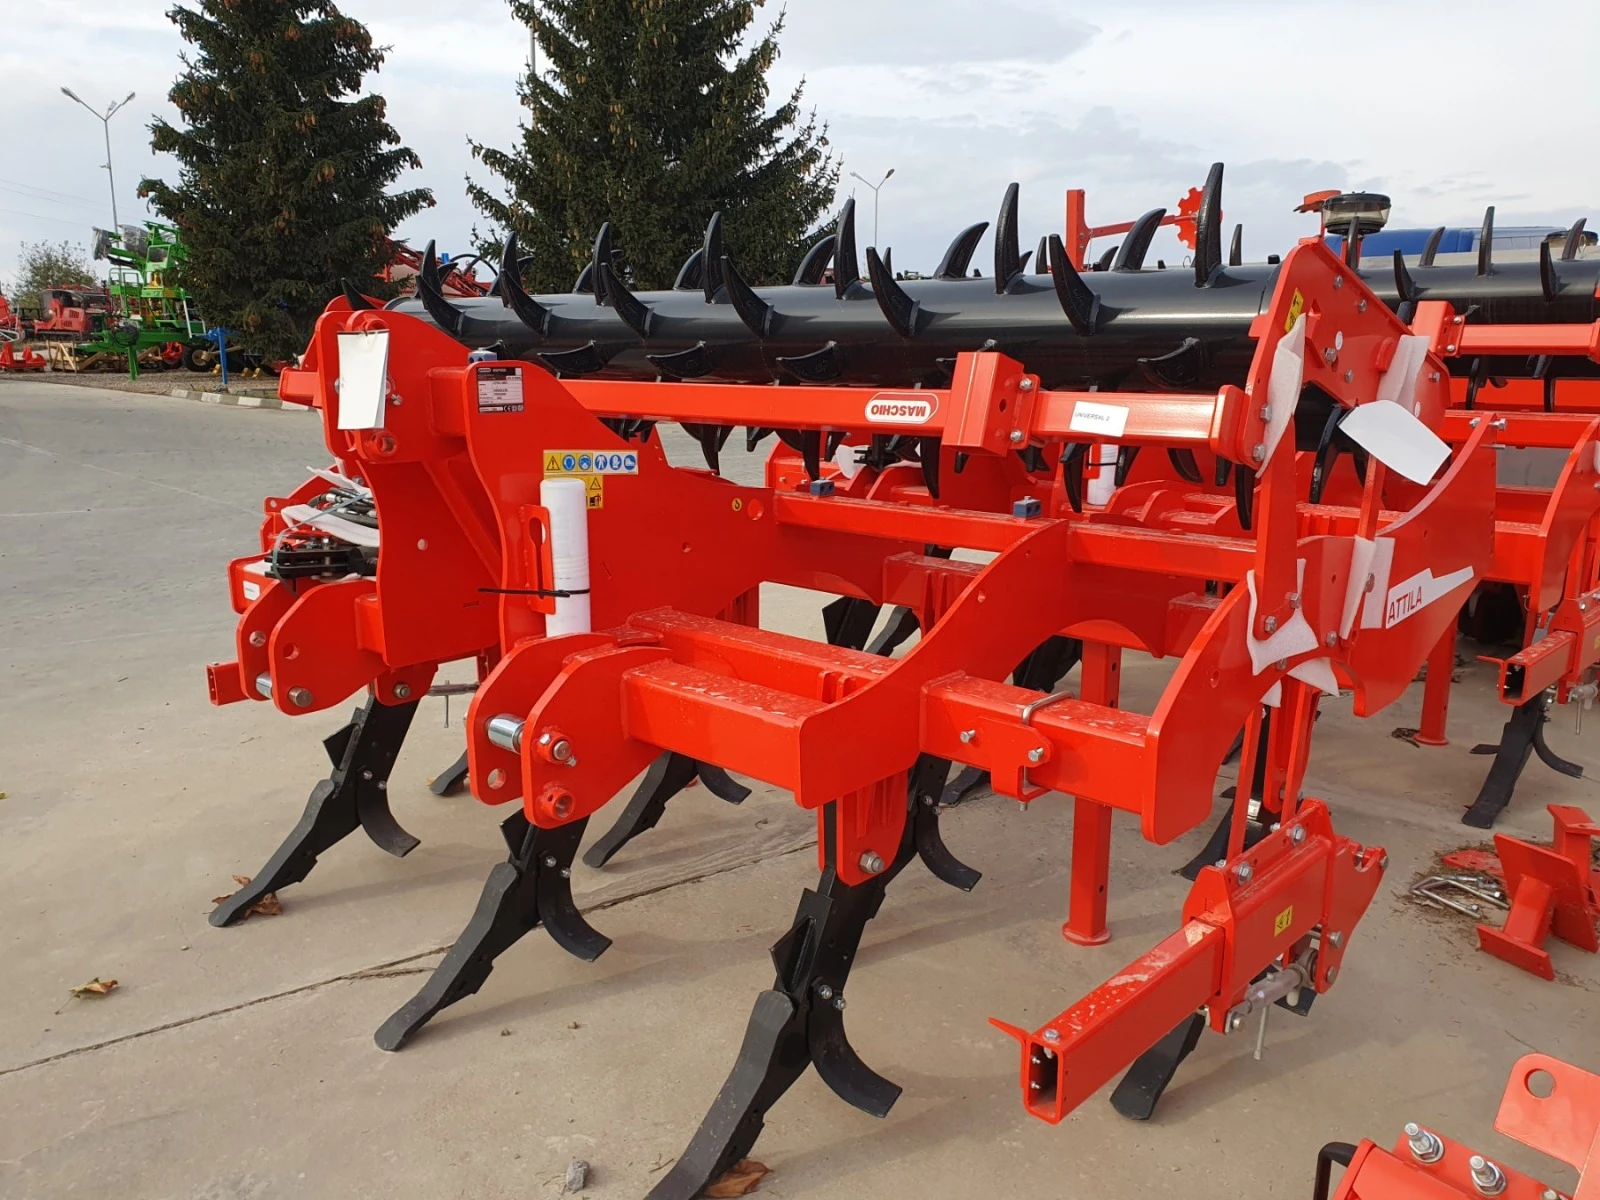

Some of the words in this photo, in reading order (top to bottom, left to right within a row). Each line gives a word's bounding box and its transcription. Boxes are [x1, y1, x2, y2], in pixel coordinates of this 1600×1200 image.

[870, 404, 927, 417] MASCHIO
[1075, 412, 1105, 421] UNIVERSAL
[1387, 585, 1422, 624] ATTILA
